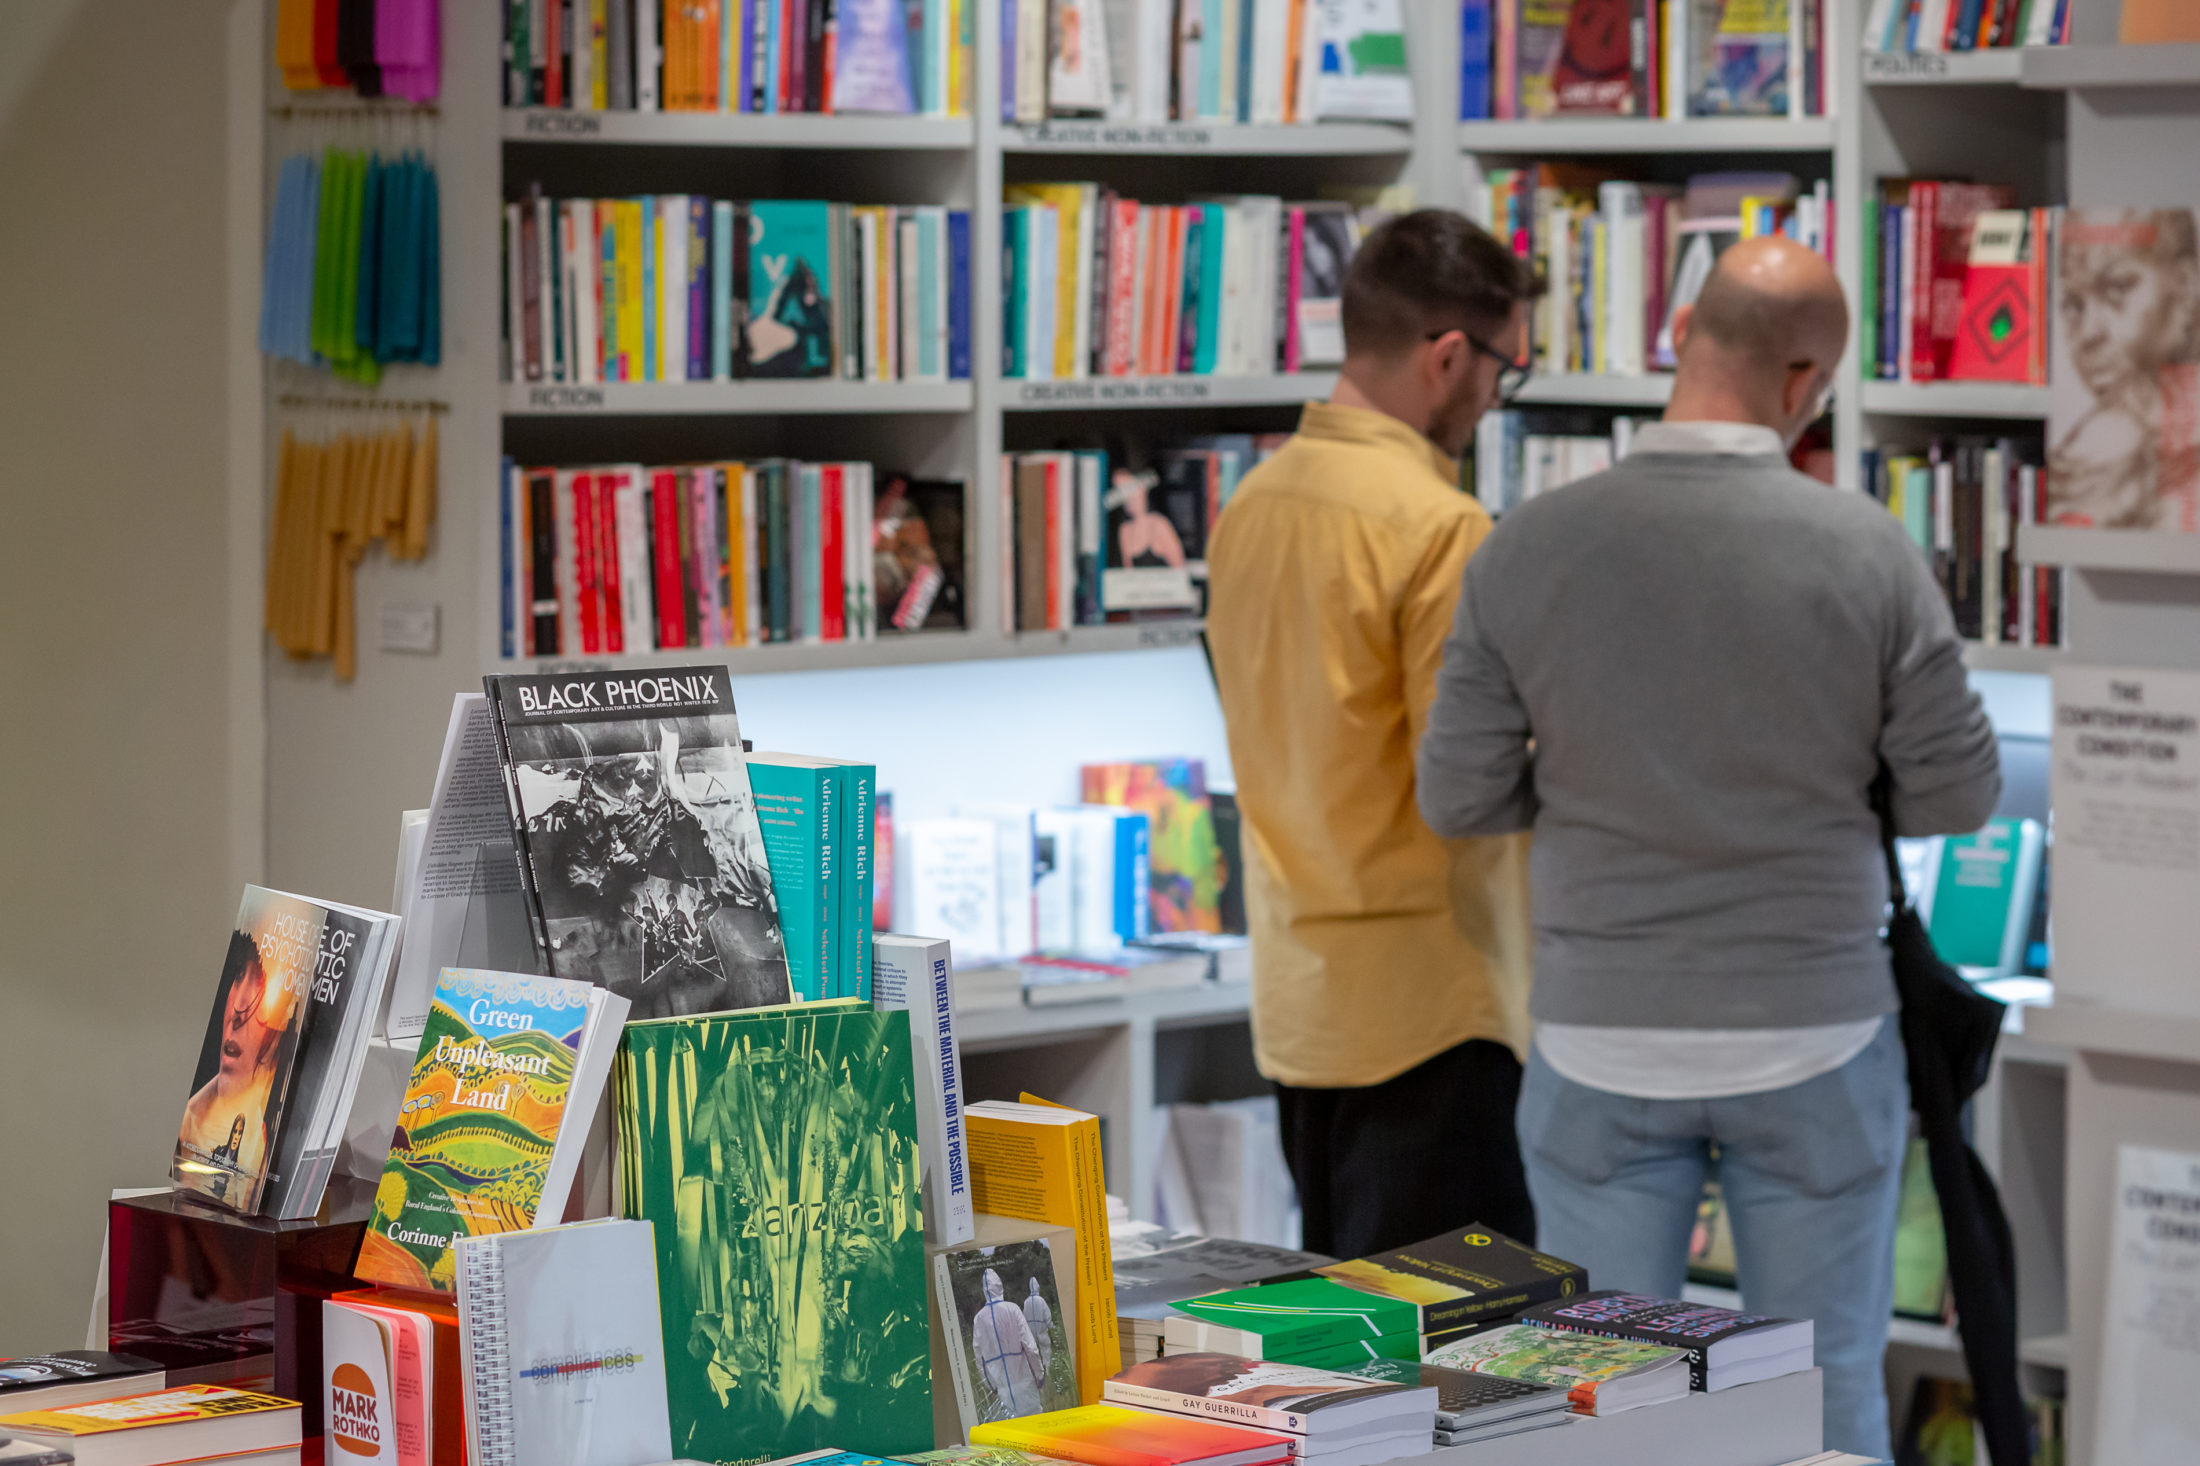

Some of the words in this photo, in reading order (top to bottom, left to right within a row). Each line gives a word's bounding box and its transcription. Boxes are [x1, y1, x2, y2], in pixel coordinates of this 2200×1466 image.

[525, 113, 599, 133] FICTION
[529, 387, 604, 407] FICTION
[519, 681, 601, 712] BLACK
[605, 675, 719, 706] PHOENIX
[552, 707, 590, 715] CONTEMPORARY
[821, 774, 831, 840] Adrienne
[856, 775, 867, 840] Adrienne
[820, 844, 830, 880] Rich
[855, 844, 866, 880] Rich
[273, 911, 310, 944] HOUSE
[330, 929, 356, 956] OF
[258, 933, 314, 973] PSYCHOTIC
[820, 927, 828, 974] Selected
[854, 928, 863, 974] Selected
[933, 959, 949, 1014] BETWEEN
[468, 998, 534, 1032] Green
[938, 1013, 951, 1035] THE
[434, 1035, 552, 1077] Unpleasant
[940, 1037, 957, 1094] MATERIAL
[449, 1078, 511, 1112] Land
[944, 1094, 958, 1119] AND
[946, 1119, 961, 1140] THE
[1071, 1136, 1079, 1150] The
[1089, 1131, 1097, 1146] The
[947, 1141, 964, 1196] POSSIBLE
[1073, 1151, 1083, 1188] Changing
[1090, 1146, 1100, 1183] Changing
[404, 1199, 420, 1209] Rural
[419, 1200, 446, 1214] England's
[1076, 1188, 1088, 1235] Constitution
[1093, 1184, 1105, 1230] Constitution
[387, 1221, 447, 1249] Corinne
[1083, 1256, 1092, 1286] Present
[1100, 1252, 1109, 1281] Present
[1428, 1306, 1459, 1322] Dreaming
[1463, 1301, 1484, 1314] Yellow
[531, 1349, 635, 1385] compliances
[189, 1394, 267, 1407] LINES
[203, 1398, 288, 1415] FRONT
[332, 1387, 377, 1423] MARK
[1182, 1398, 1201, 1410] GAY
[1204, 1402, 1258, 1419] GUERRILLA
[332, 1415, 380, 1443] ROTHKO
